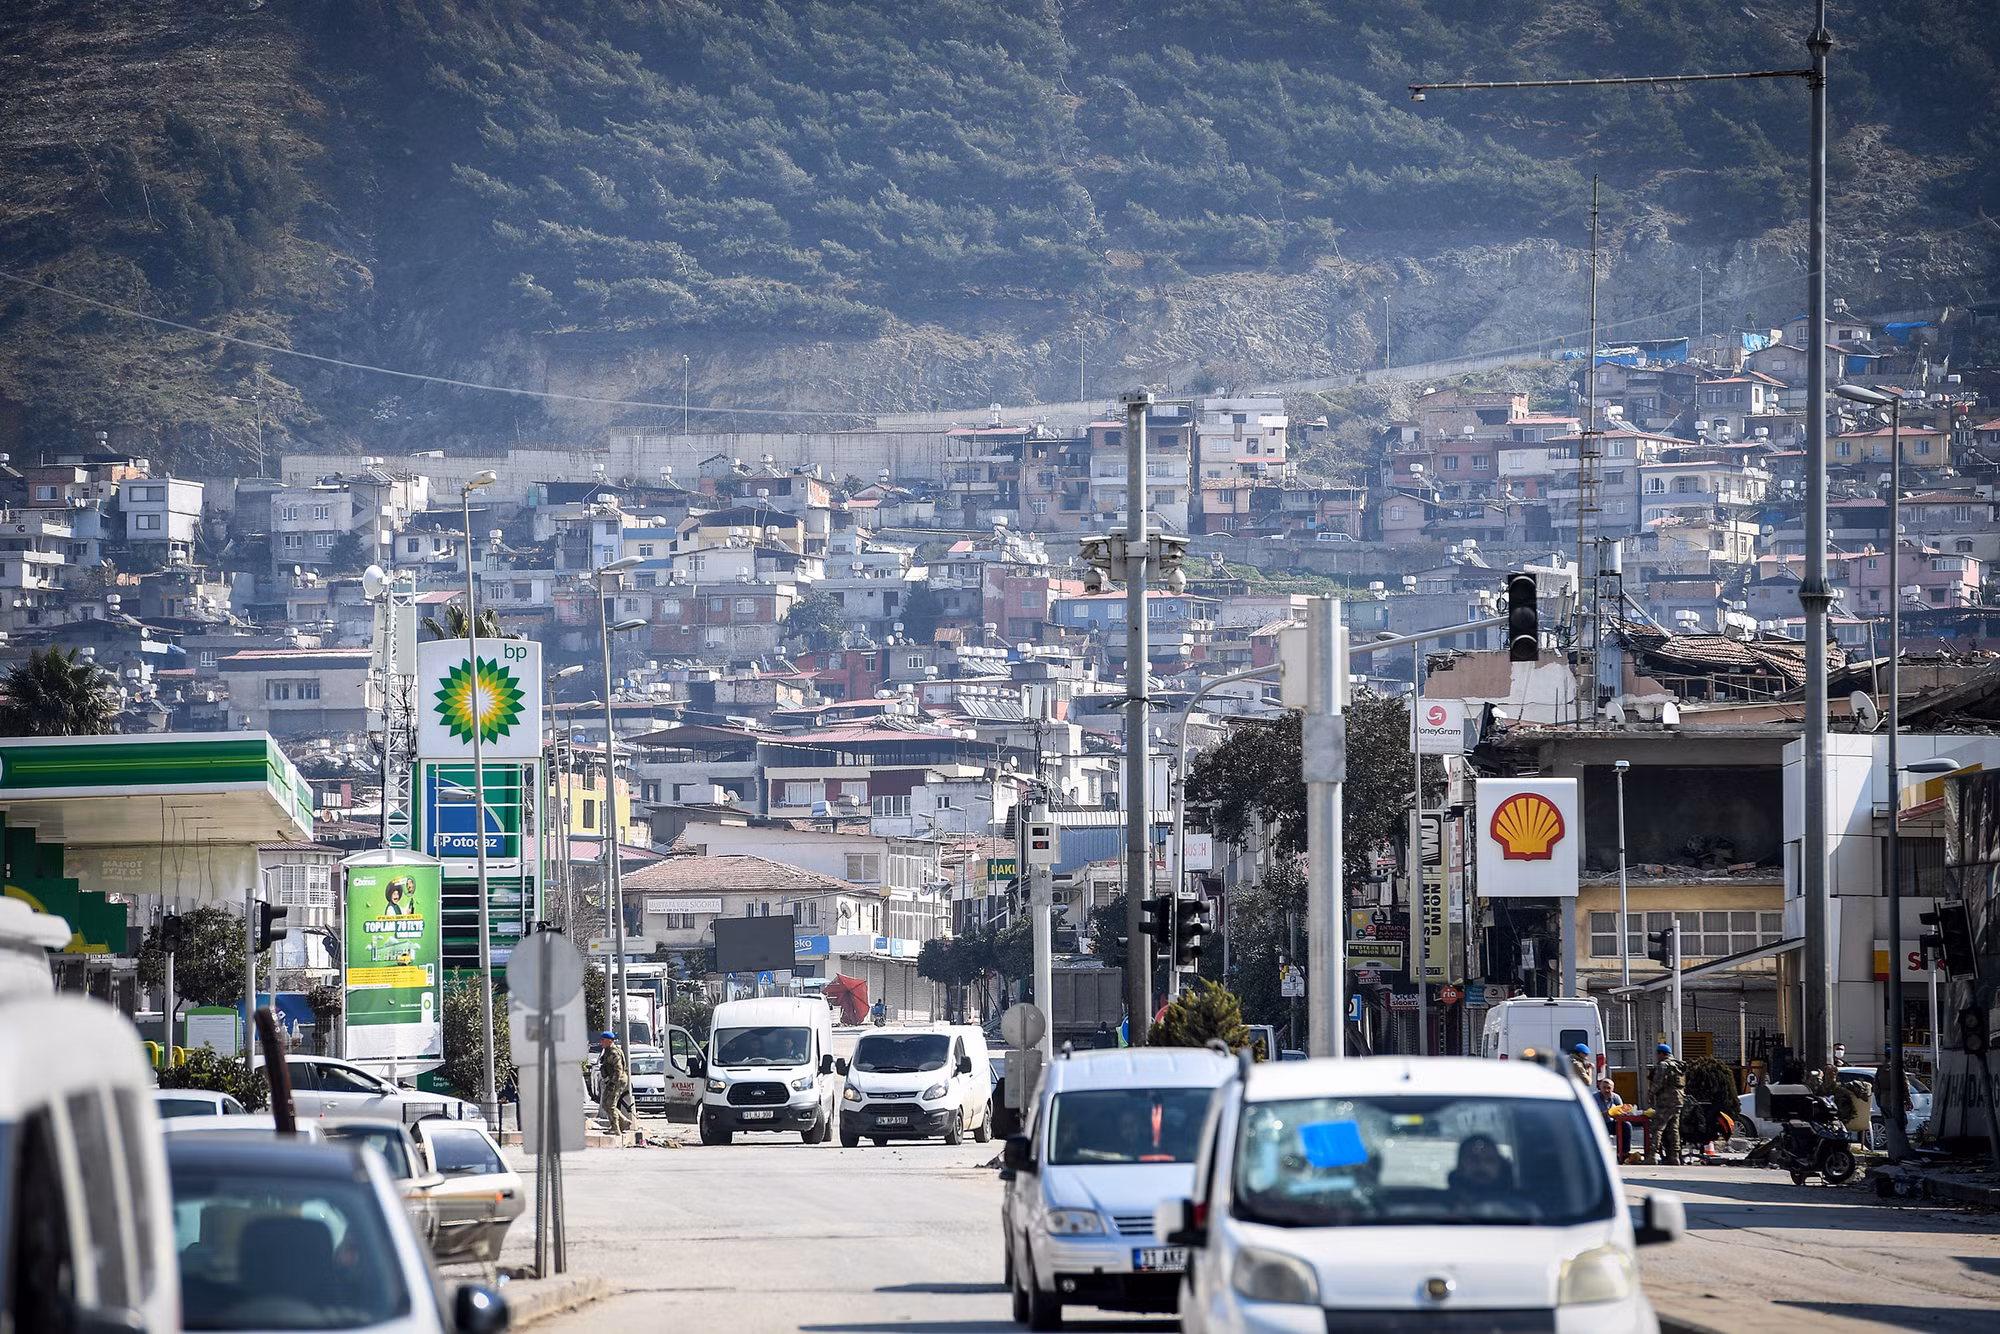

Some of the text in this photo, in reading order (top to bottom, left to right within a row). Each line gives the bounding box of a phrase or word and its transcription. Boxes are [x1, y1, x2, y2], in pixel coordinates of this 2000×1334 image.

[504, 643, 528, 662] bp
[1431, 883, 1441, 936] UNION
[365, 921, 396, 932] TOPLAM
[794, 938, 812, 948] eko
[1383, 946, 1400, 955] WU
[1443, 988, 1456, 998] ria
